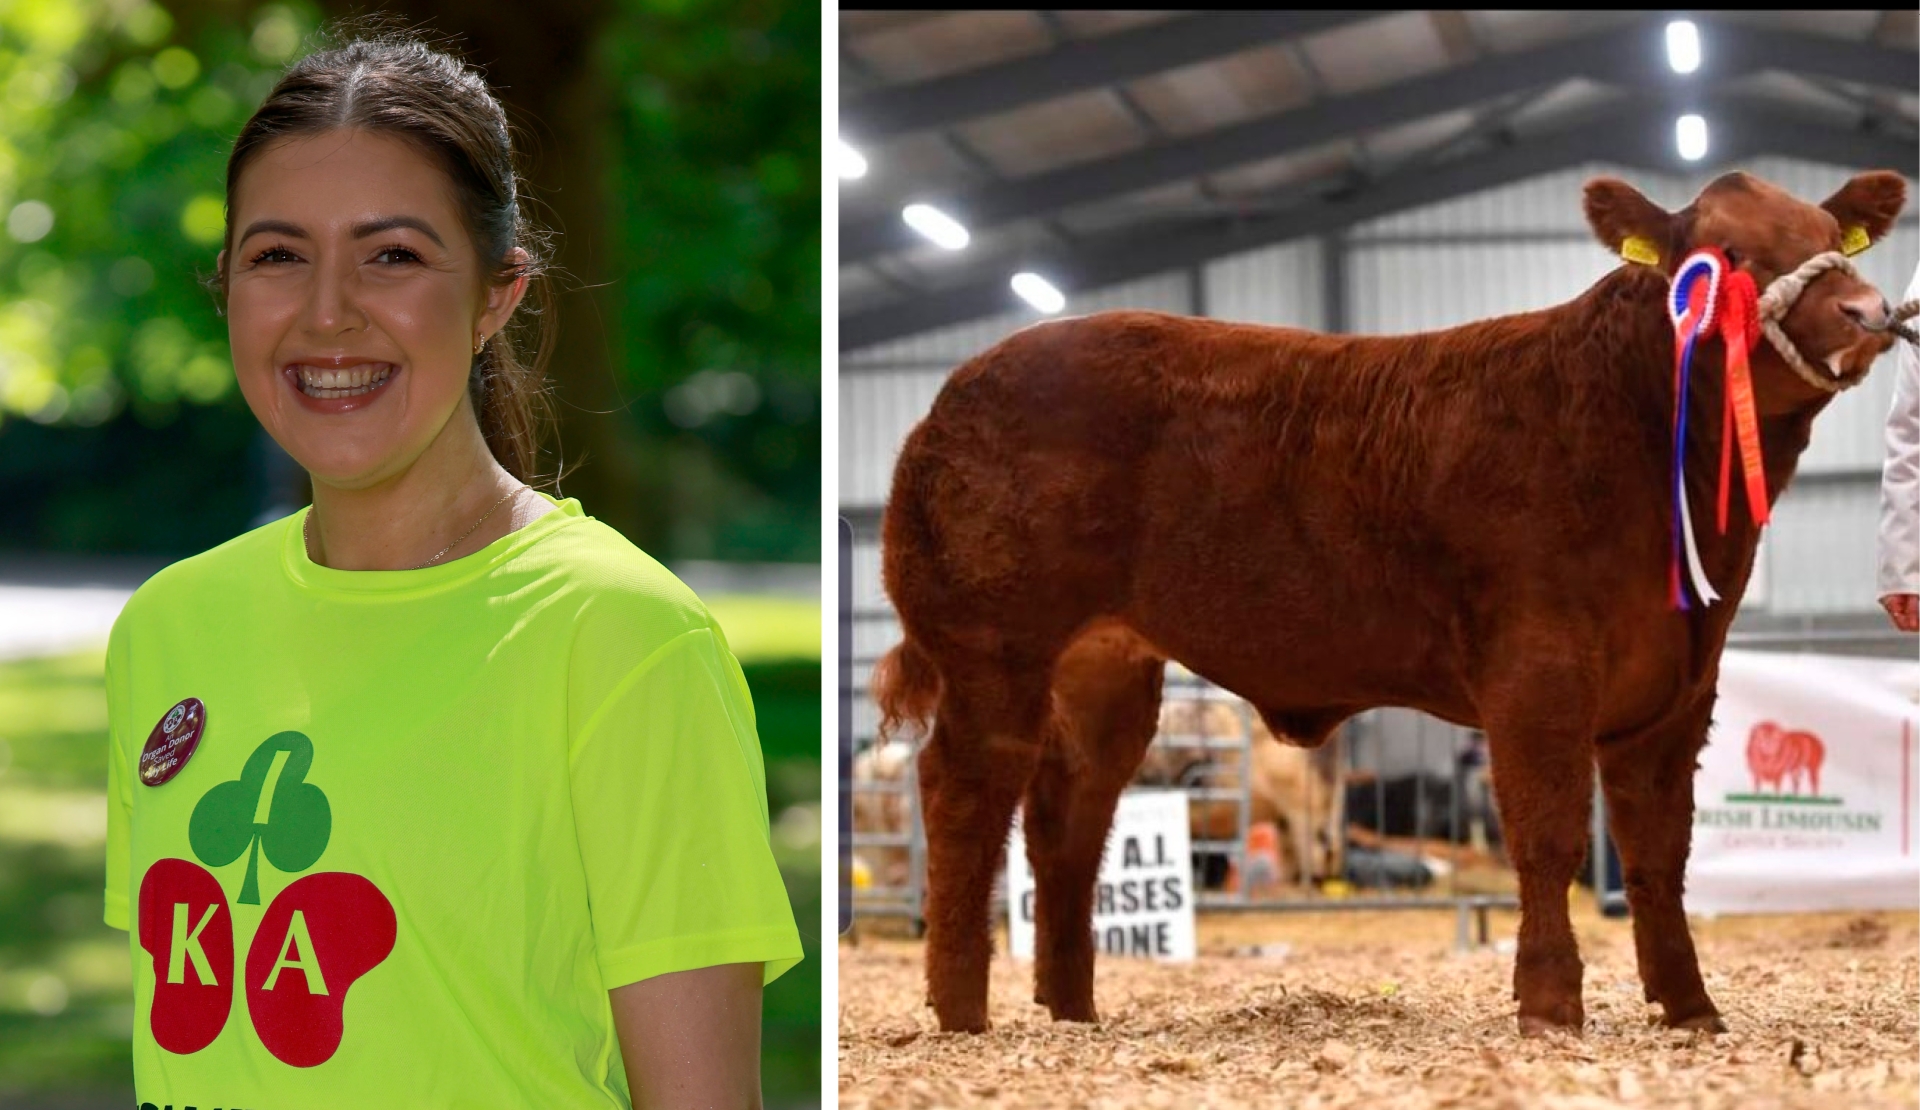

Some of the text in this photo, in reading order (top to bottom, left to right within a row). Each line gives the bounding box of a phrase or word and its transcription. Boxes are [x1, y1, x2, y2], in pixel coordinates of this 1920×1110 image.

[142, 730, 195, 762] Organ Donor
[153, 748, 176, 765] Saved
[161, 757, 178, 772] Life
[1123, 834, 1174, 868] A.I.
[1021, 878, 1183, 922] CRSES
